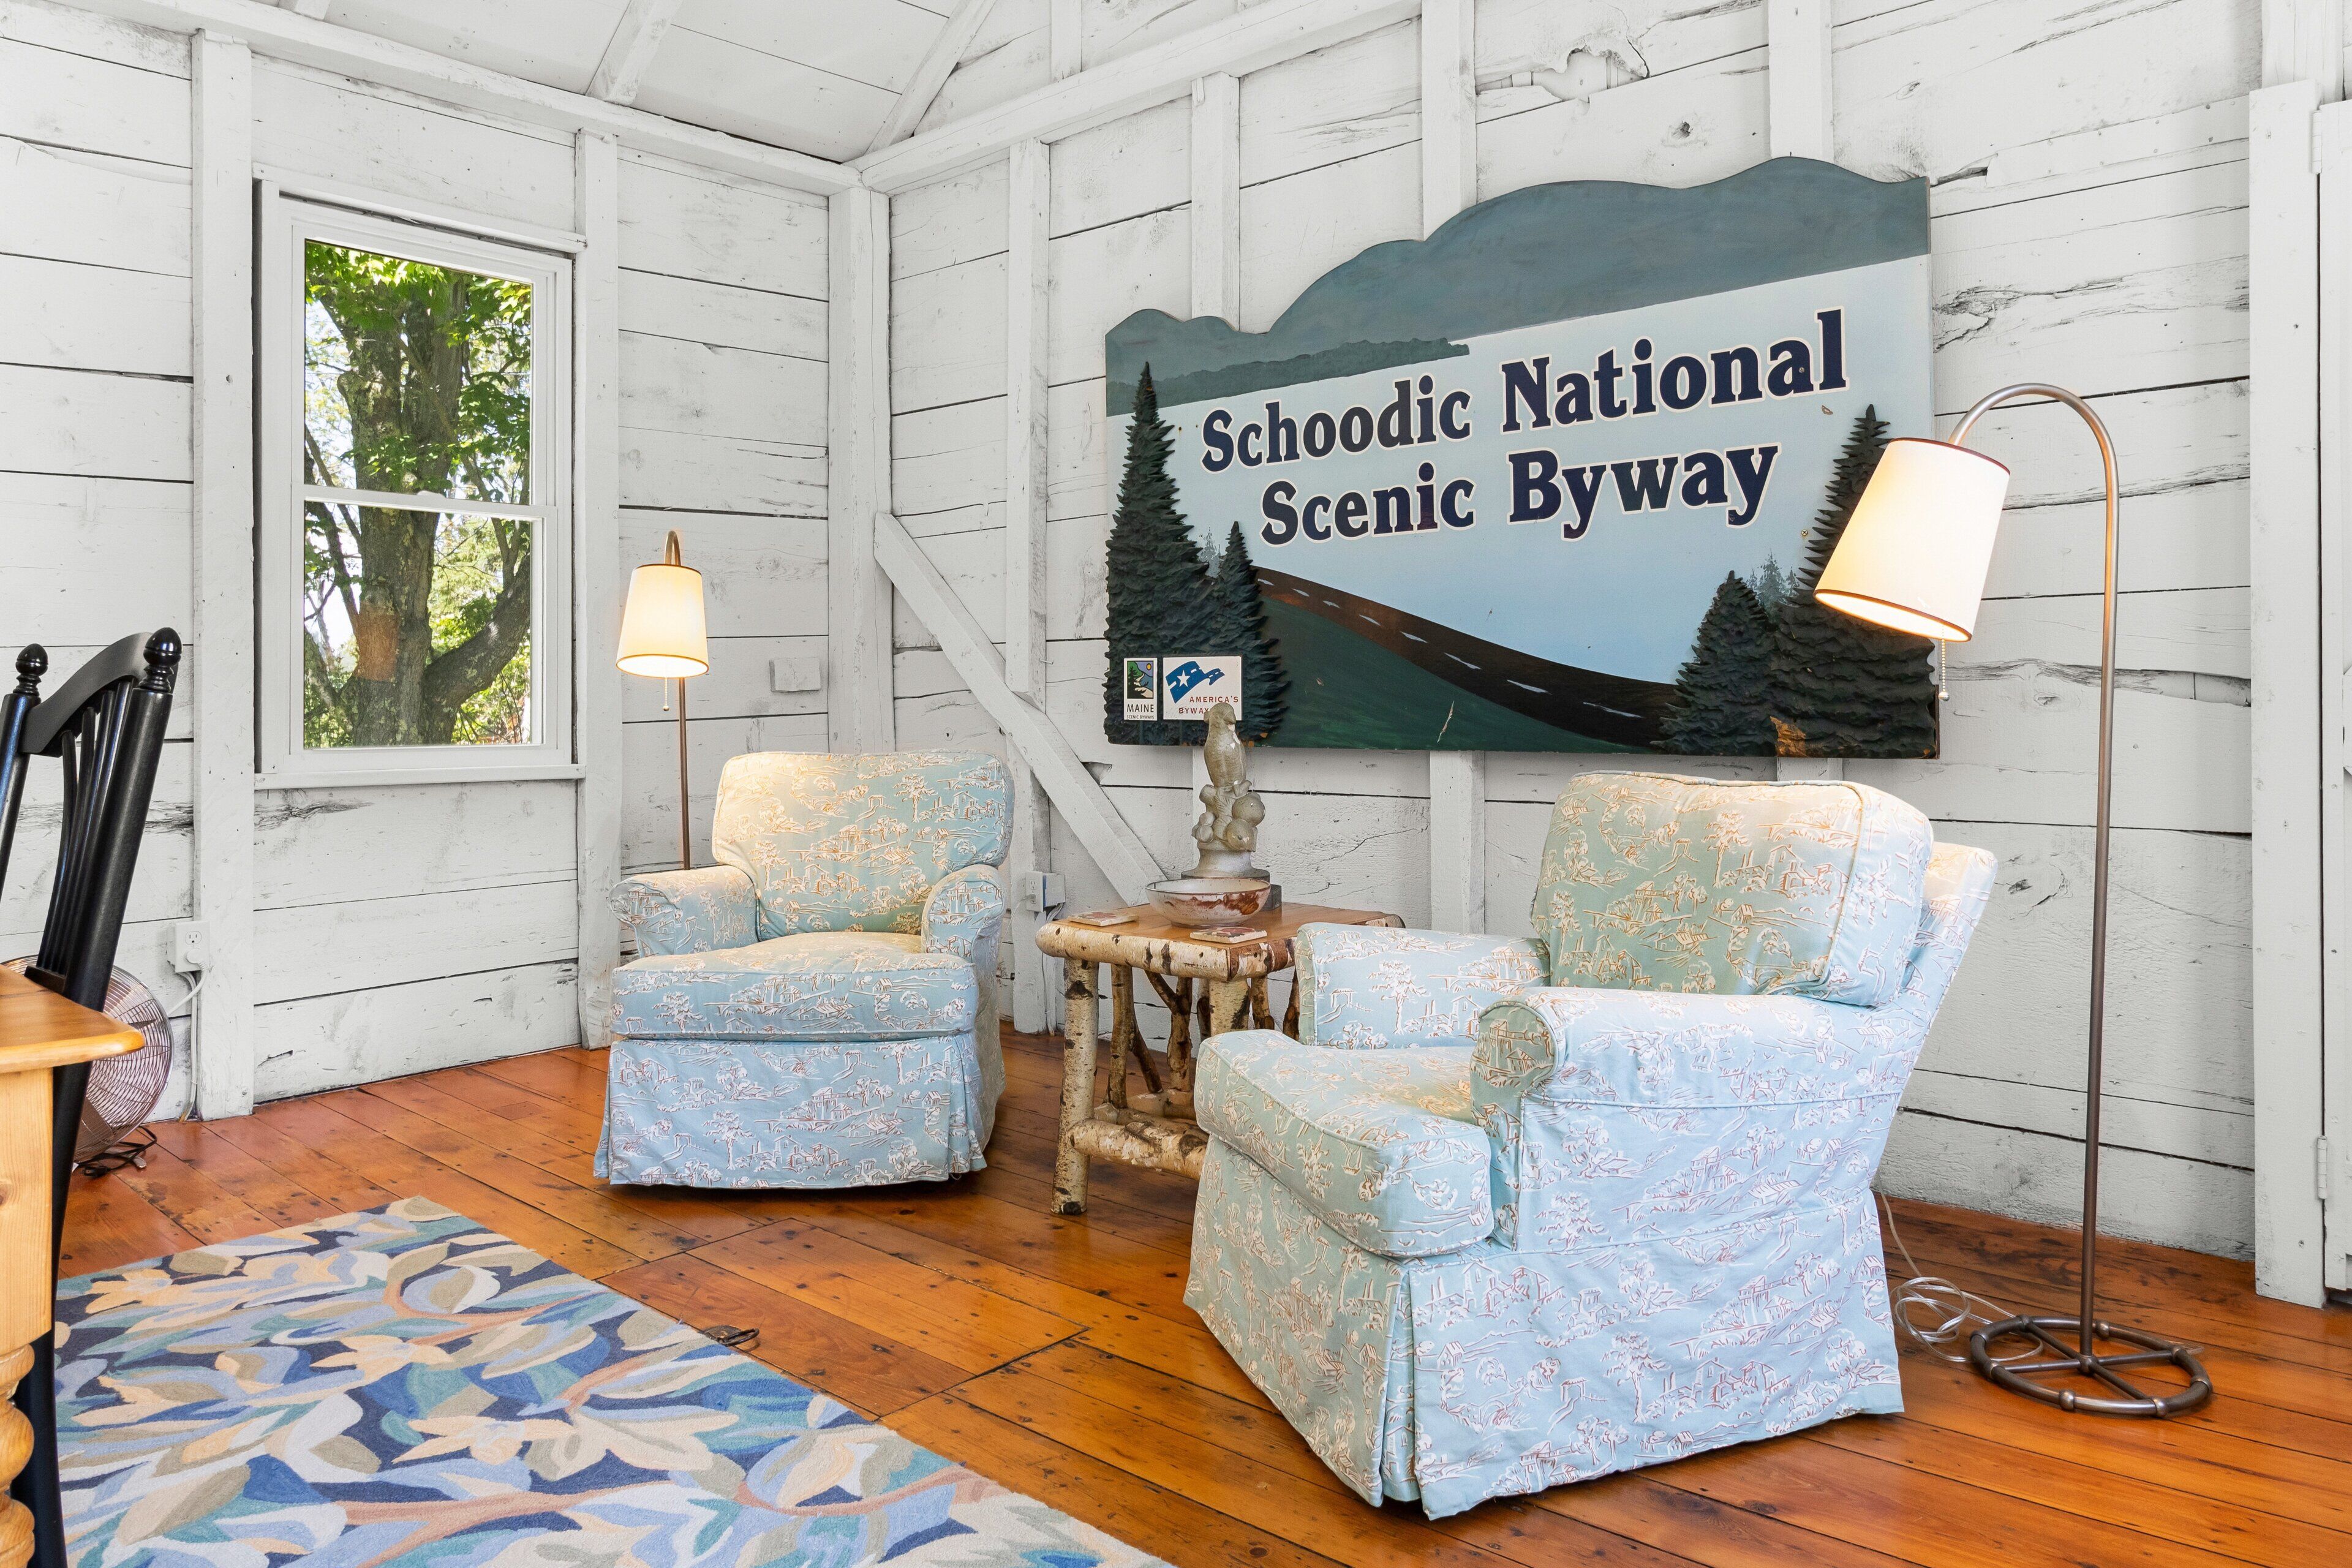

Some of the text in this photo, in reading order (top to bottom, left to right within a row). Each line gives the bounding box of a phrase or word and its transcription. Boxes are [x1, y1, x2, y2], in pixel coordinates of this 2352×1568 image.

[1201, 307, 1847, 474] Schoodic National
[1261, 443, 1780, 547] Scenic Byway
[1127, 704, 1154, 712] MAINE
